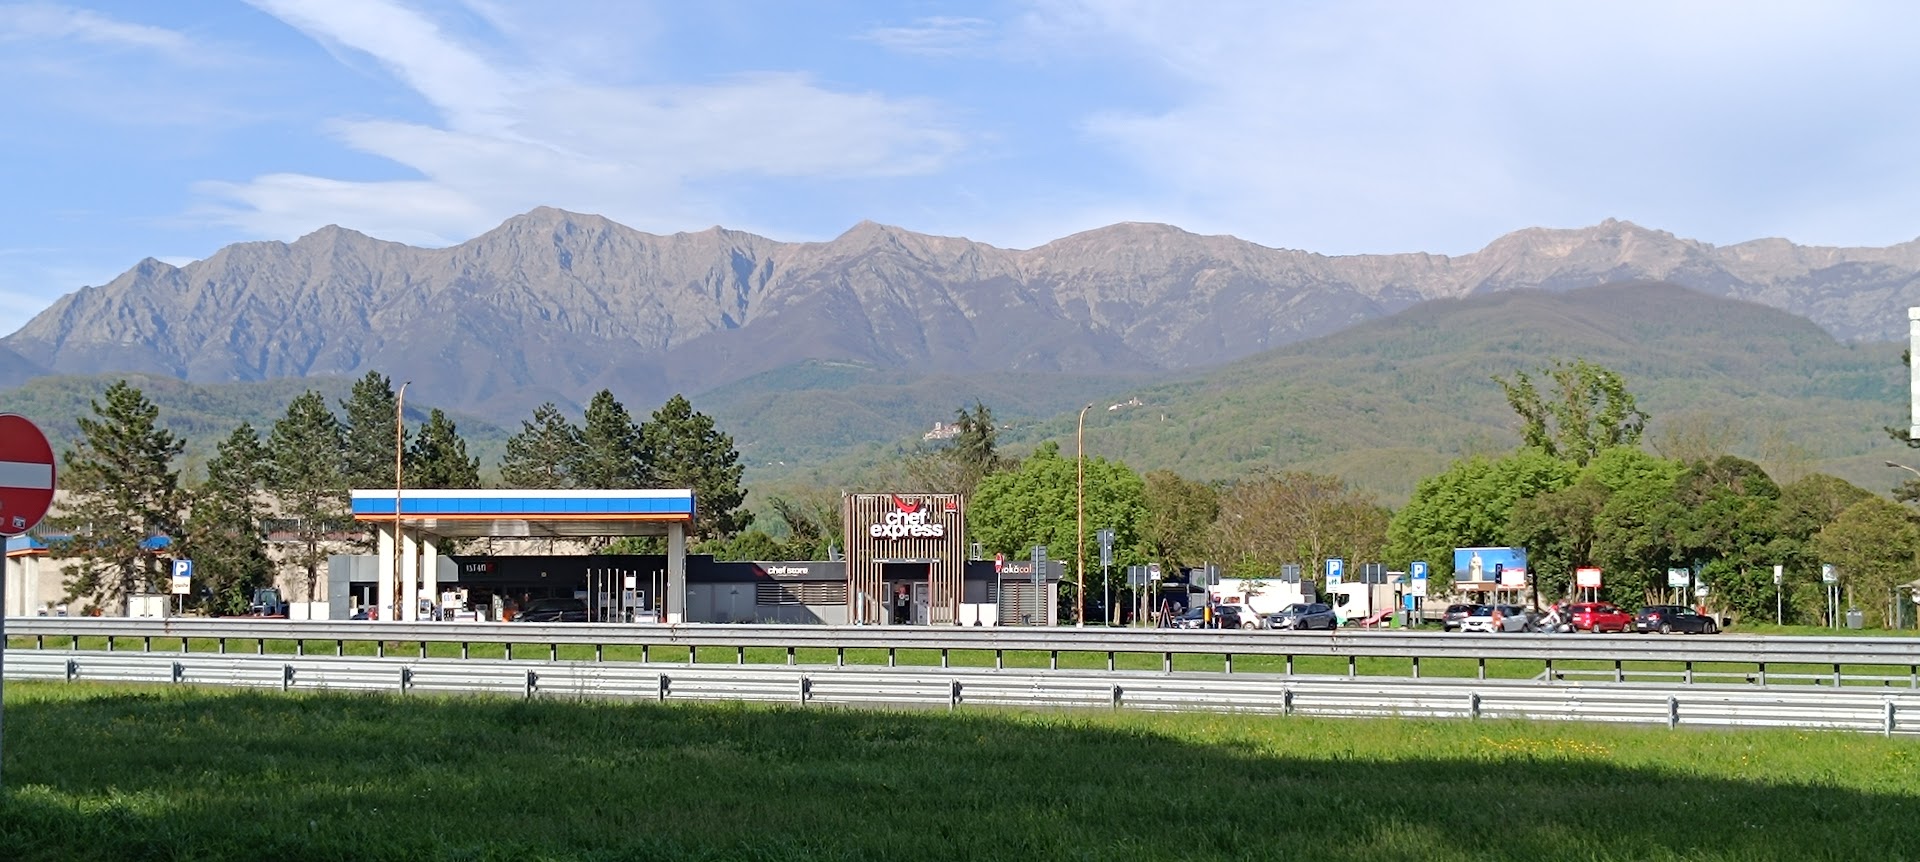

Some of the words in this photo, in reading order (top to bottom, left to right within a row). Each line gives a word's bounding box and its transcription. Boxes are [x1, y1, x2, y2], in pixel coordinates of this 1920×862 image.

[885, 508, 927, 524] chef
[870, 523, 944, 540] express
[176, 562, 188, 575] P
[768, 566, 787, 575] chef
[1329, 561, 1340, 575] P
[1414, 564, 1424, 577] P
